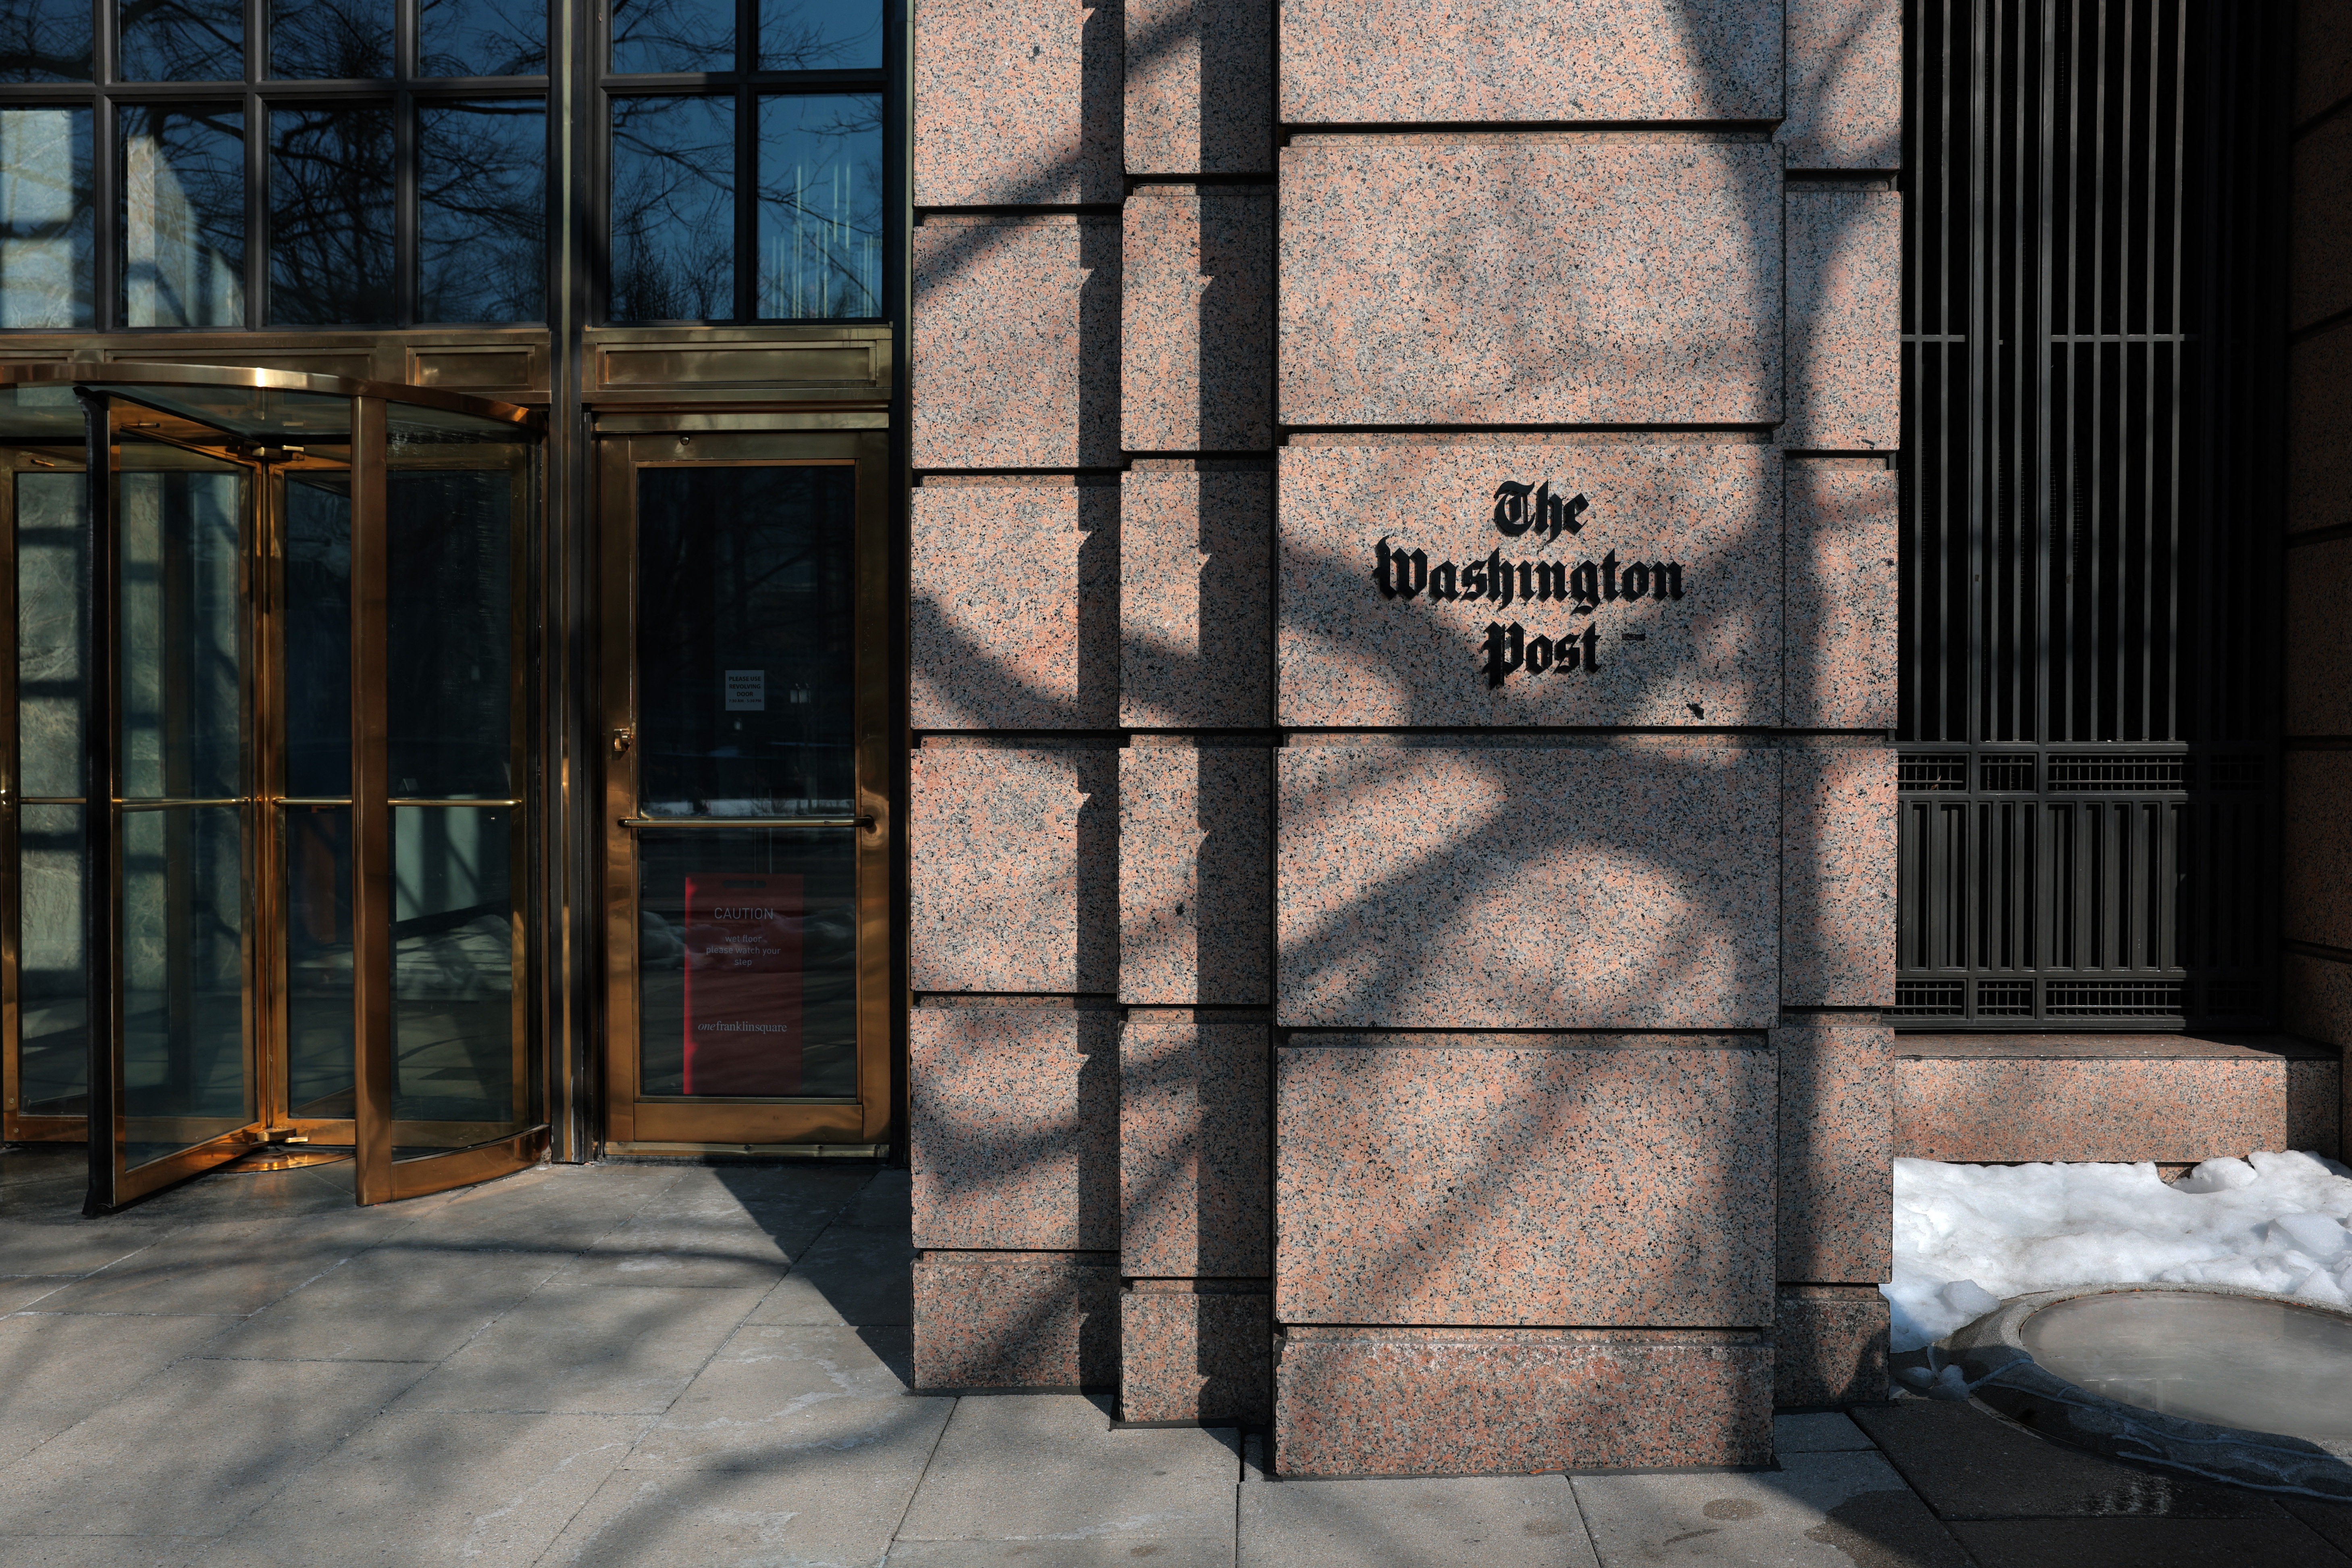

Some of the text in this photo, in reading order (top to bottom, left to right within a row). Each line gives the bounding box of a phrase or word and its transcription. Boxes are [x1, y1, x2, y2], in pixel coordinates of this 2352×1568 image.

[1493, 480, 1591, 545] The
[1373, 534, 1687, 615] Washington
[1480, 621, 1602, 690] Post
[714, 907, 773, 919] CAUTION
[706, 946, 733, 955] please
[734, 959, 752, 967] step
[698, 1021, 787, 1034] onefranklinsquare
